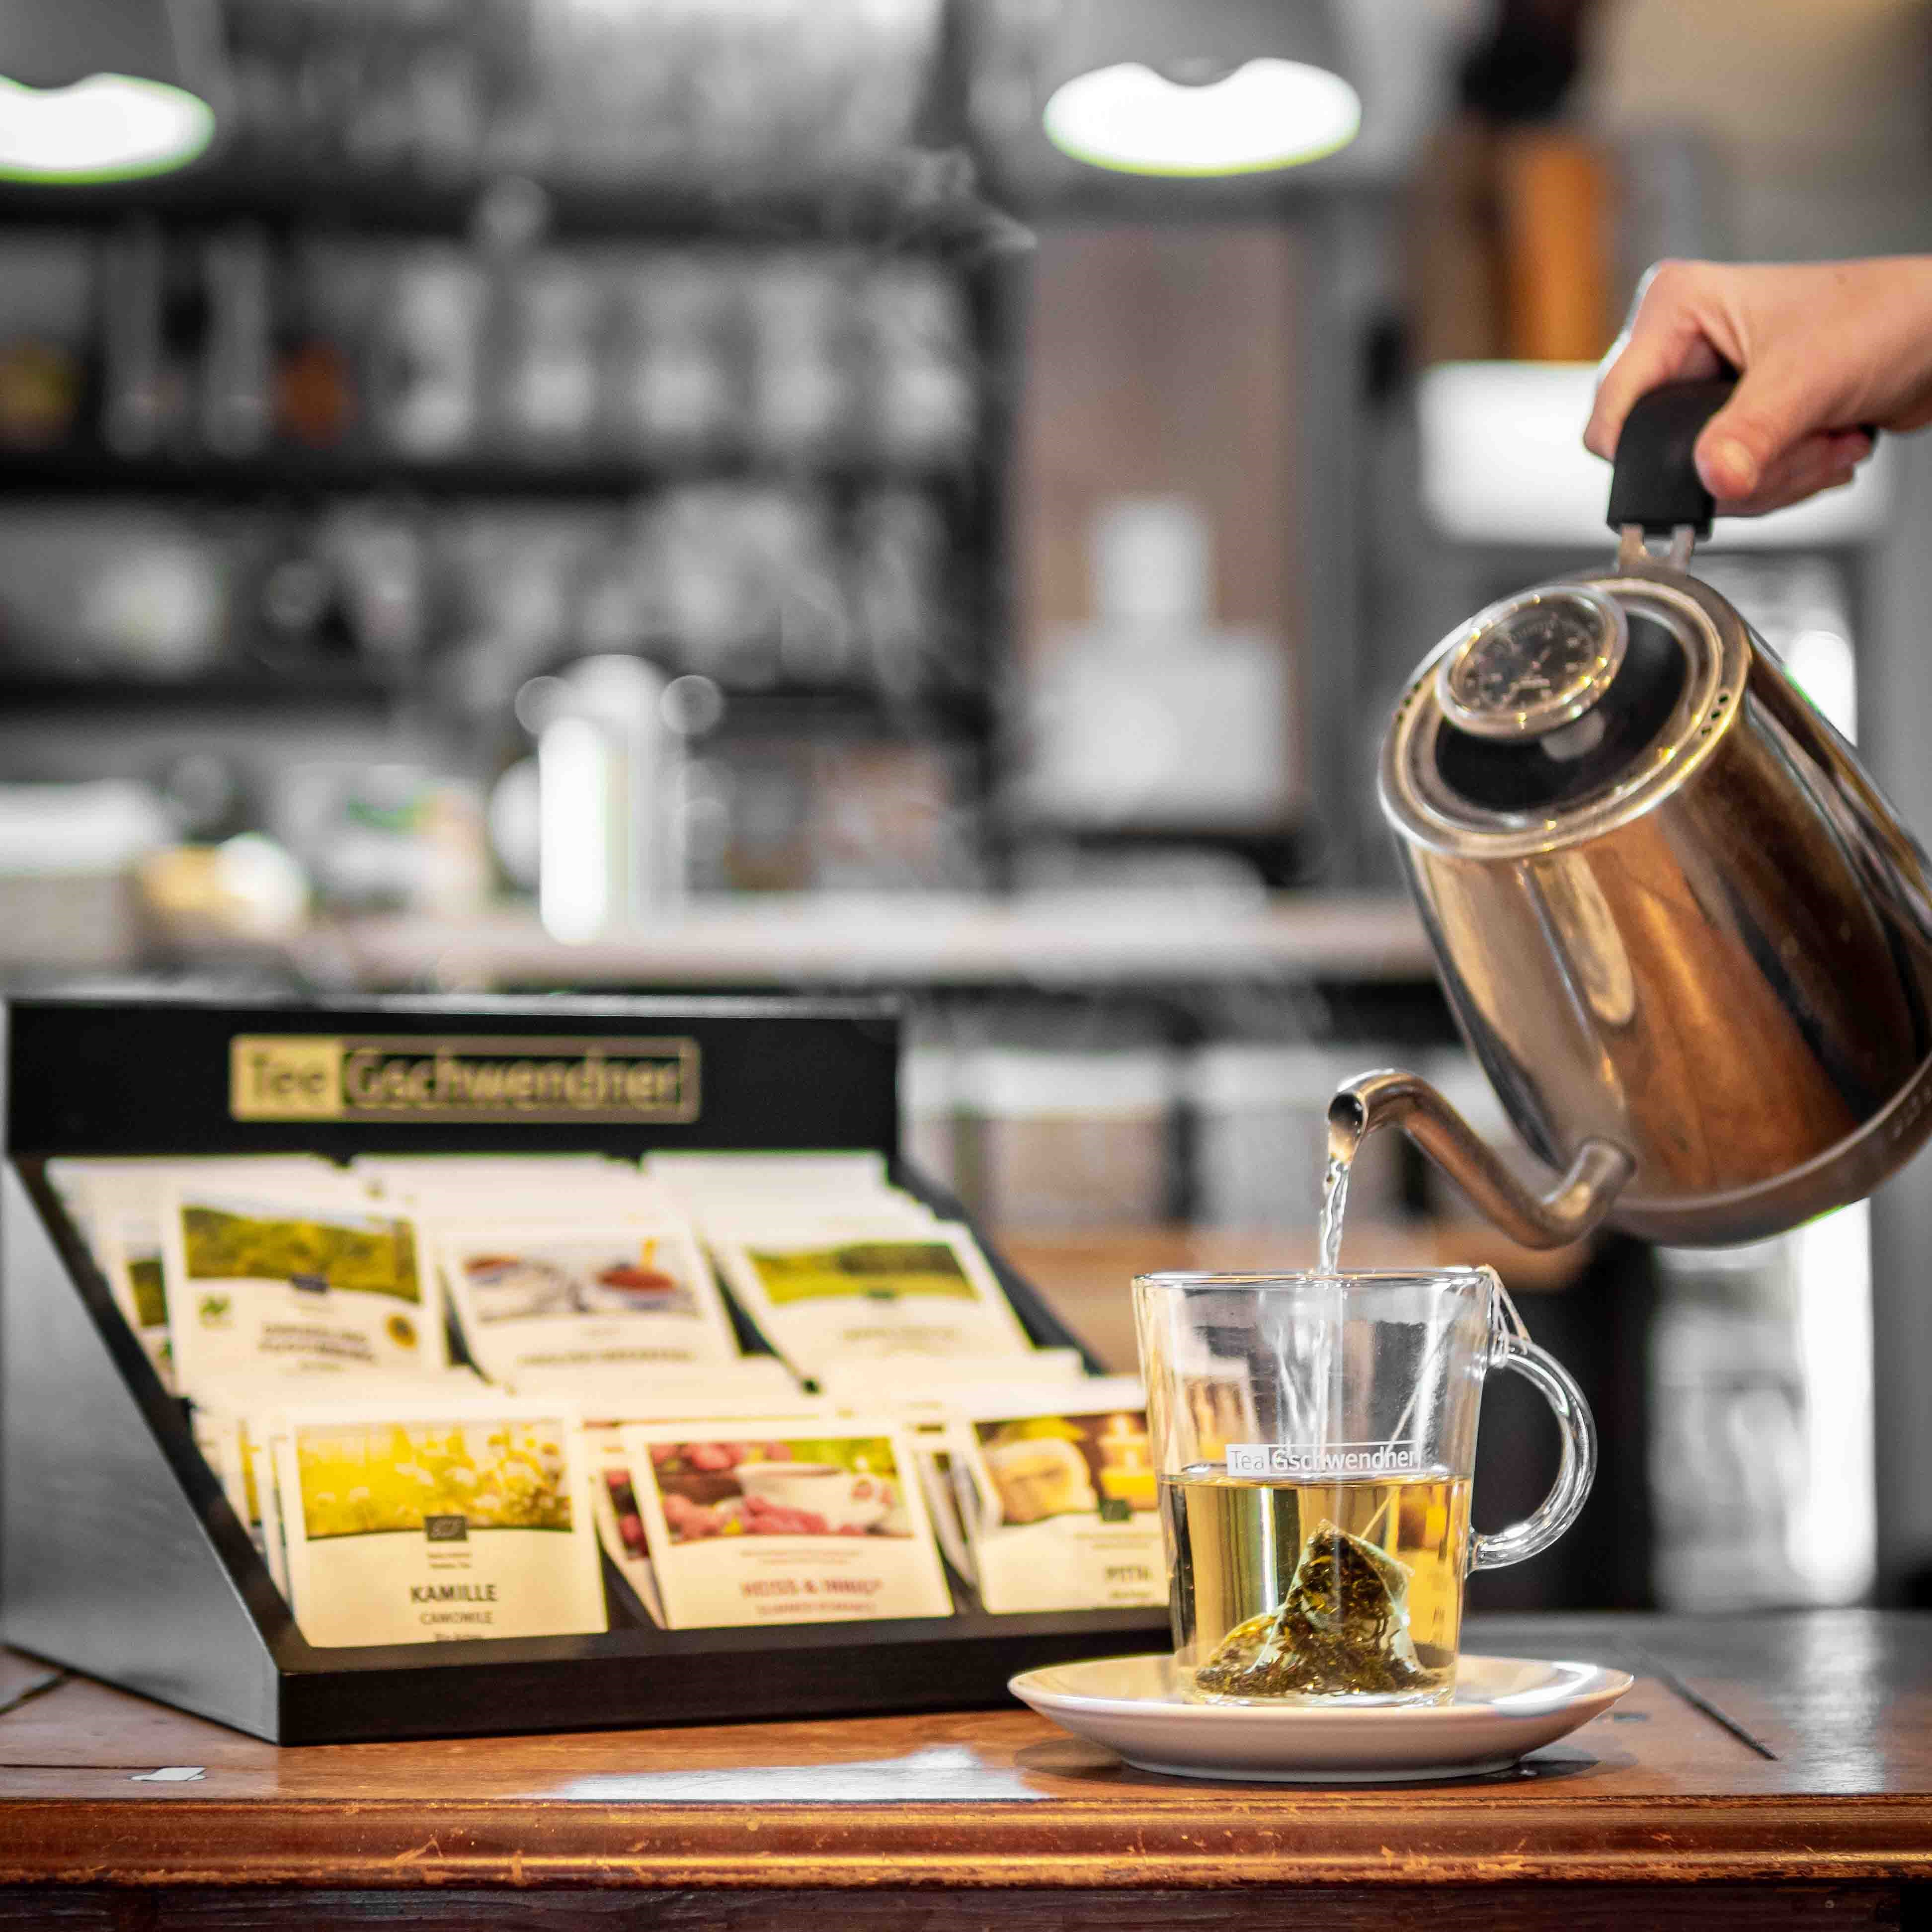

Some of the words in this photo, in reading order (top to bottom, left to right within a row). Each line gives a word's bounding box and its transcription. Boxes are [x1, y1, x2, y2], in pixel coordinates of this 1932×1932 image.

[347, 1046, 681, 1108] Gschwendner
[1230, 1450, 1264, 1470] Tea
[410, 1583, 498, 1604] KAMILLE
